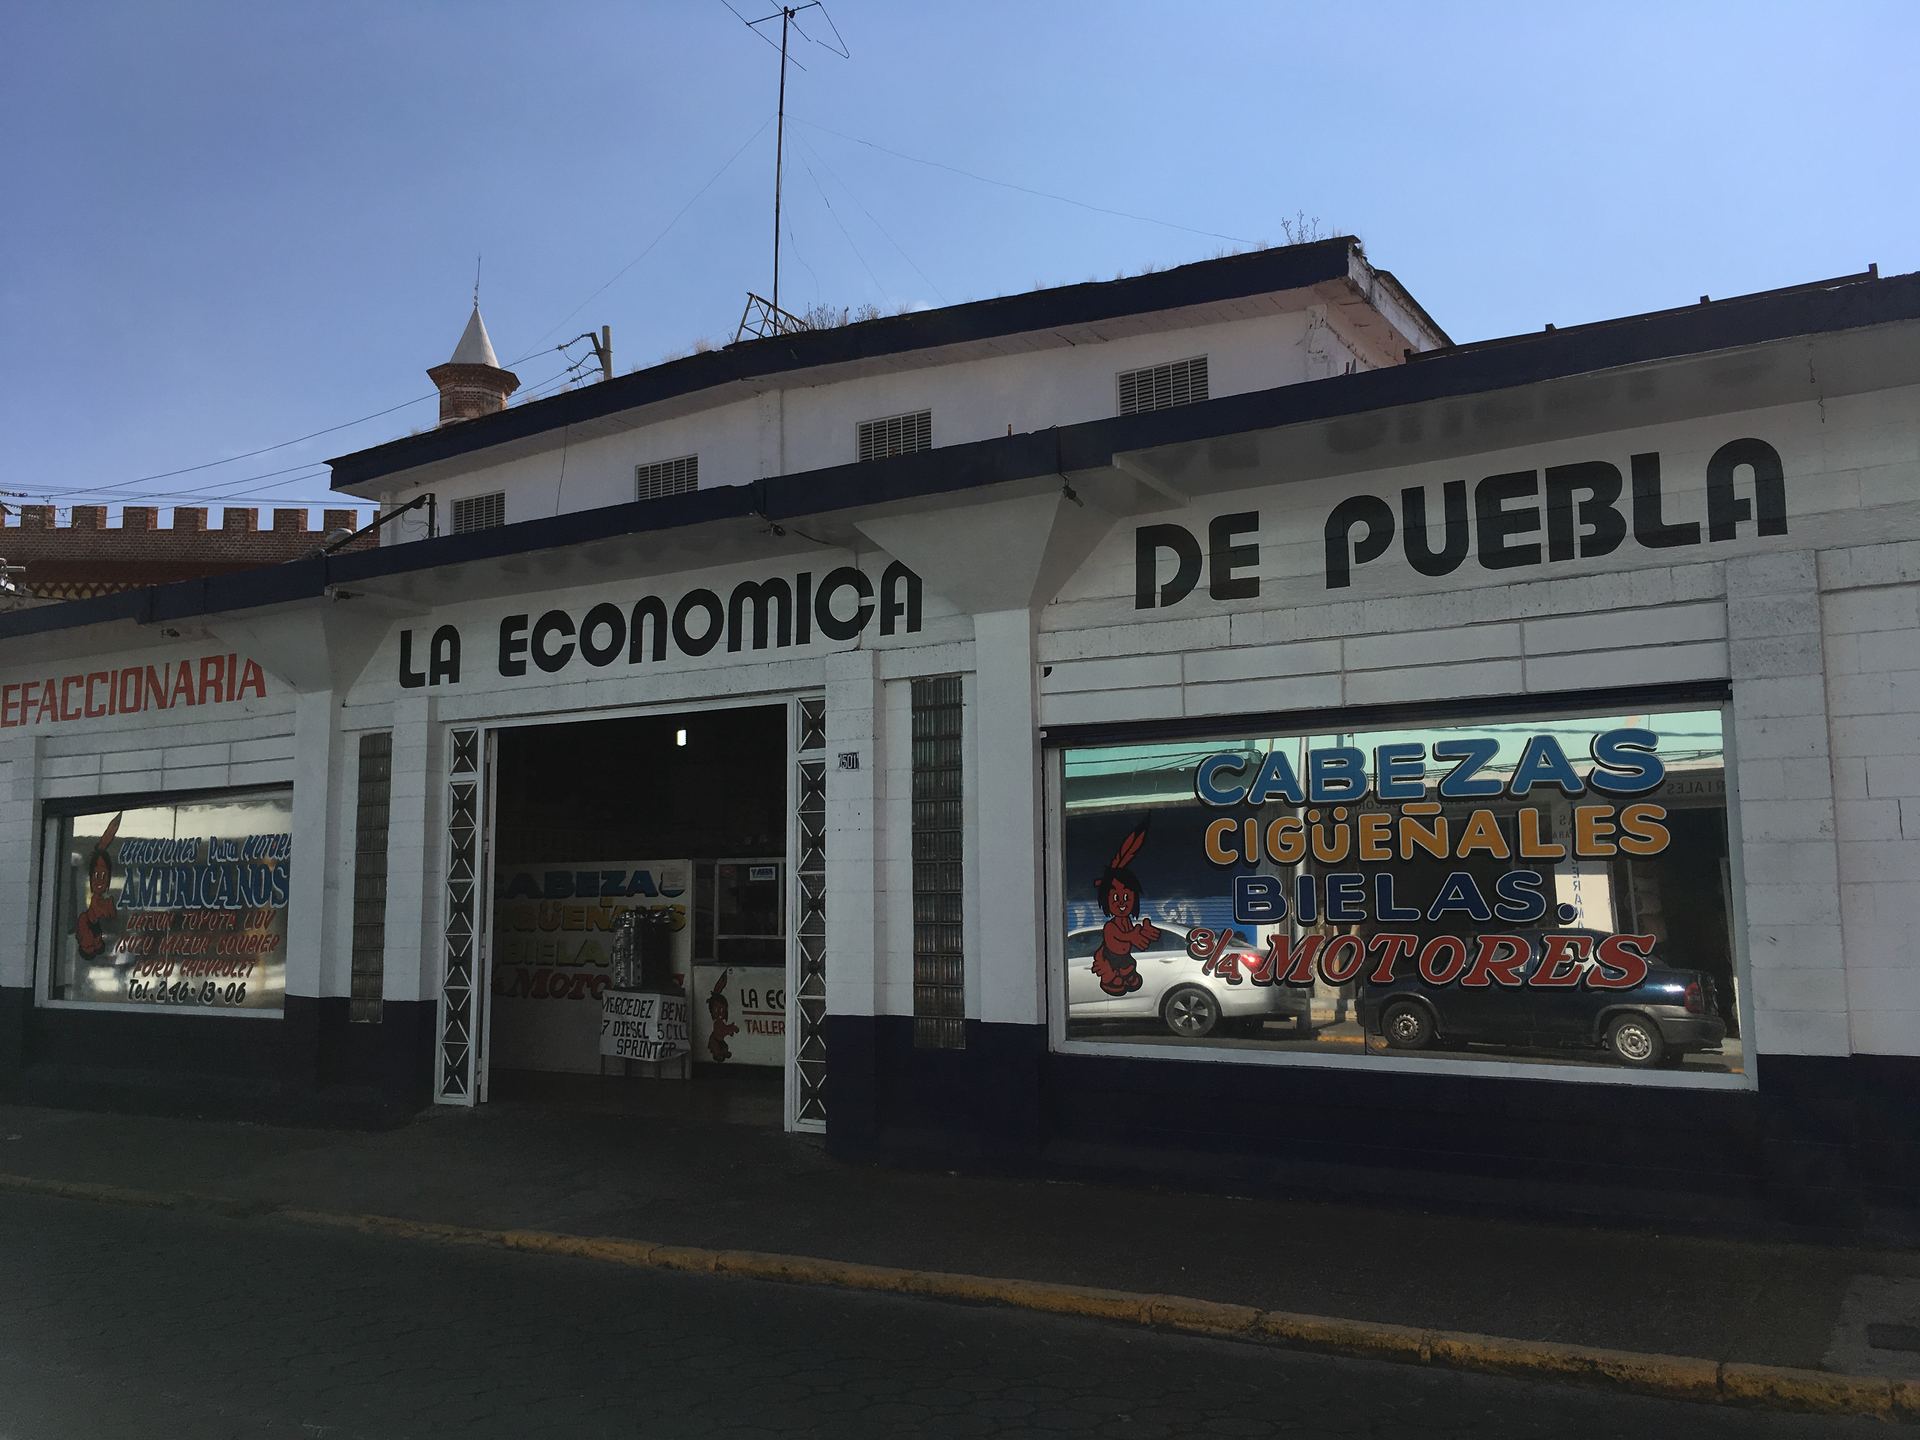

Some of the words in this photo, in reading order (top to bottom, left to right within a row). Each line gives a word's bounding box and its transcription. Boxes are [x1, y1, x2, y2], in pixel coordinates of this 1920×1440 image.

[1135, 511, 1260, 610] DE
[1325, 438, 1788, 589] PUEBLA
[400, 624, 461, 688] LA
[499, 560, 922, 677] ECONOMICA
[1194, 729, 1665, 807] CABEZAS
[1203, 803, 1671, 869] CIGÜEÑALES
[116, 863, 289, 910] AMERICANOS
[1231, 871, 1577, 926] BIELAS.
[132, 958, 174, 978] FORD
[179, 959, 255, 979] CHEVROLET
[1186, 928, 1244, 985] 3/4
[1252, 933, 1657, 991] MOTORES
[128, 979, 153, 1001] Tel.
[741, 989, 758, 1008] LA
[613, 1020, 649, 1039] DIESEL
[616, 1038, 677, 1059] SPRINTER
